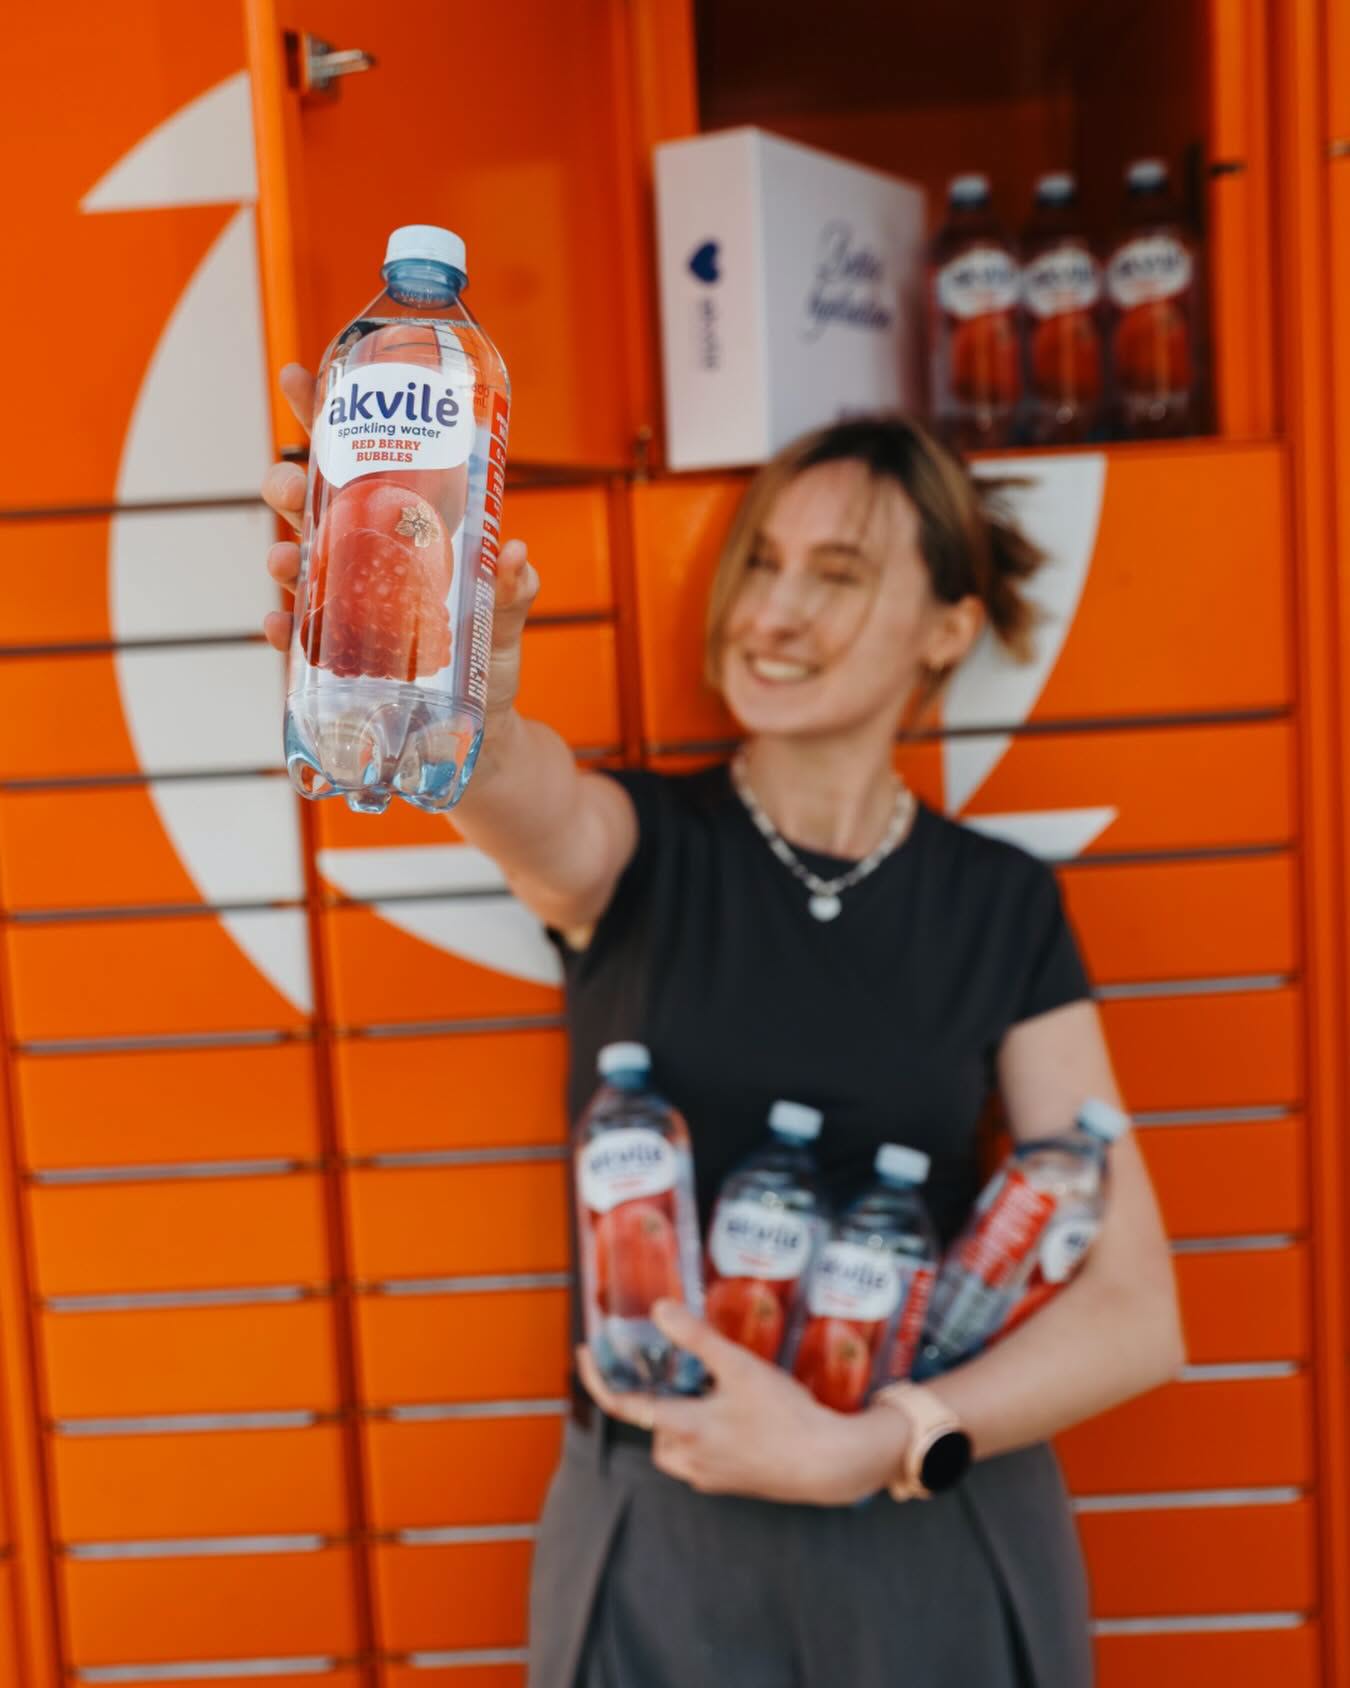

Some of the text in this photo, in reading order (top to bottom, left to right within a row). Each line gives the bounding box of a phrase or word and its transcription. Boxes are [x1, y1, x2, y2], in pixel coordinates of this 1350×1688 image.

[329, 382, 459, 427] akvilė
[338, 422, 441, 439] sparkling water
[351, 439, 422, 451] RED BERRY
[356, 452, 413, 463] BUBBLES
